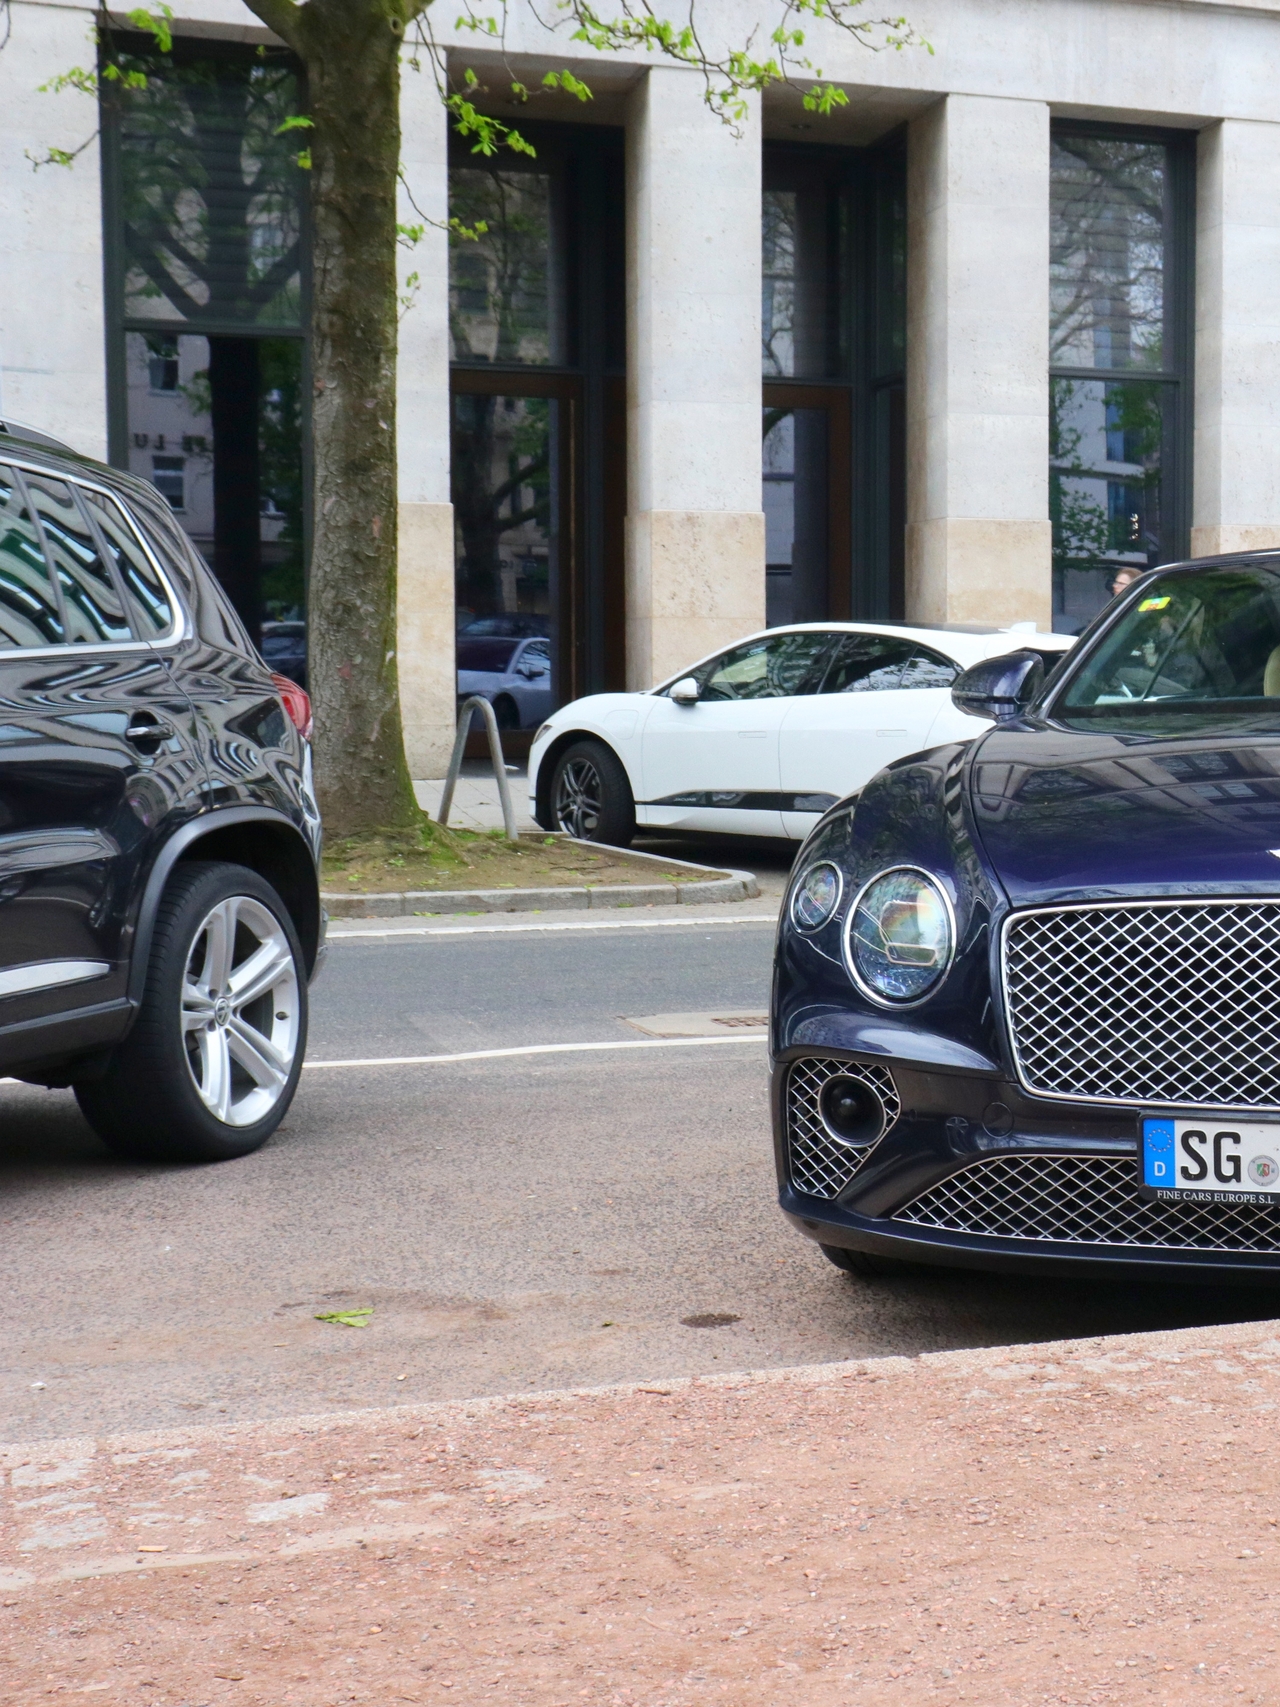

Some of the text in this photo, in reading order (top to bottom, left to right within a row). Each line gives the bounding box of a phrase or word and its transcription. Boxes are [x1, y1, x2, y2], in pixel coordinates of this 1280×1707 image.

[1180, 1129, 1242, 1184] SG
[1153, 1161, 1166, 1177] D
[1157, 1190, 1181, 1200] FINE
[1182, 1191, 1212, 1202] CARS
[1213, 1193, 1257, 1204] EUROPE
